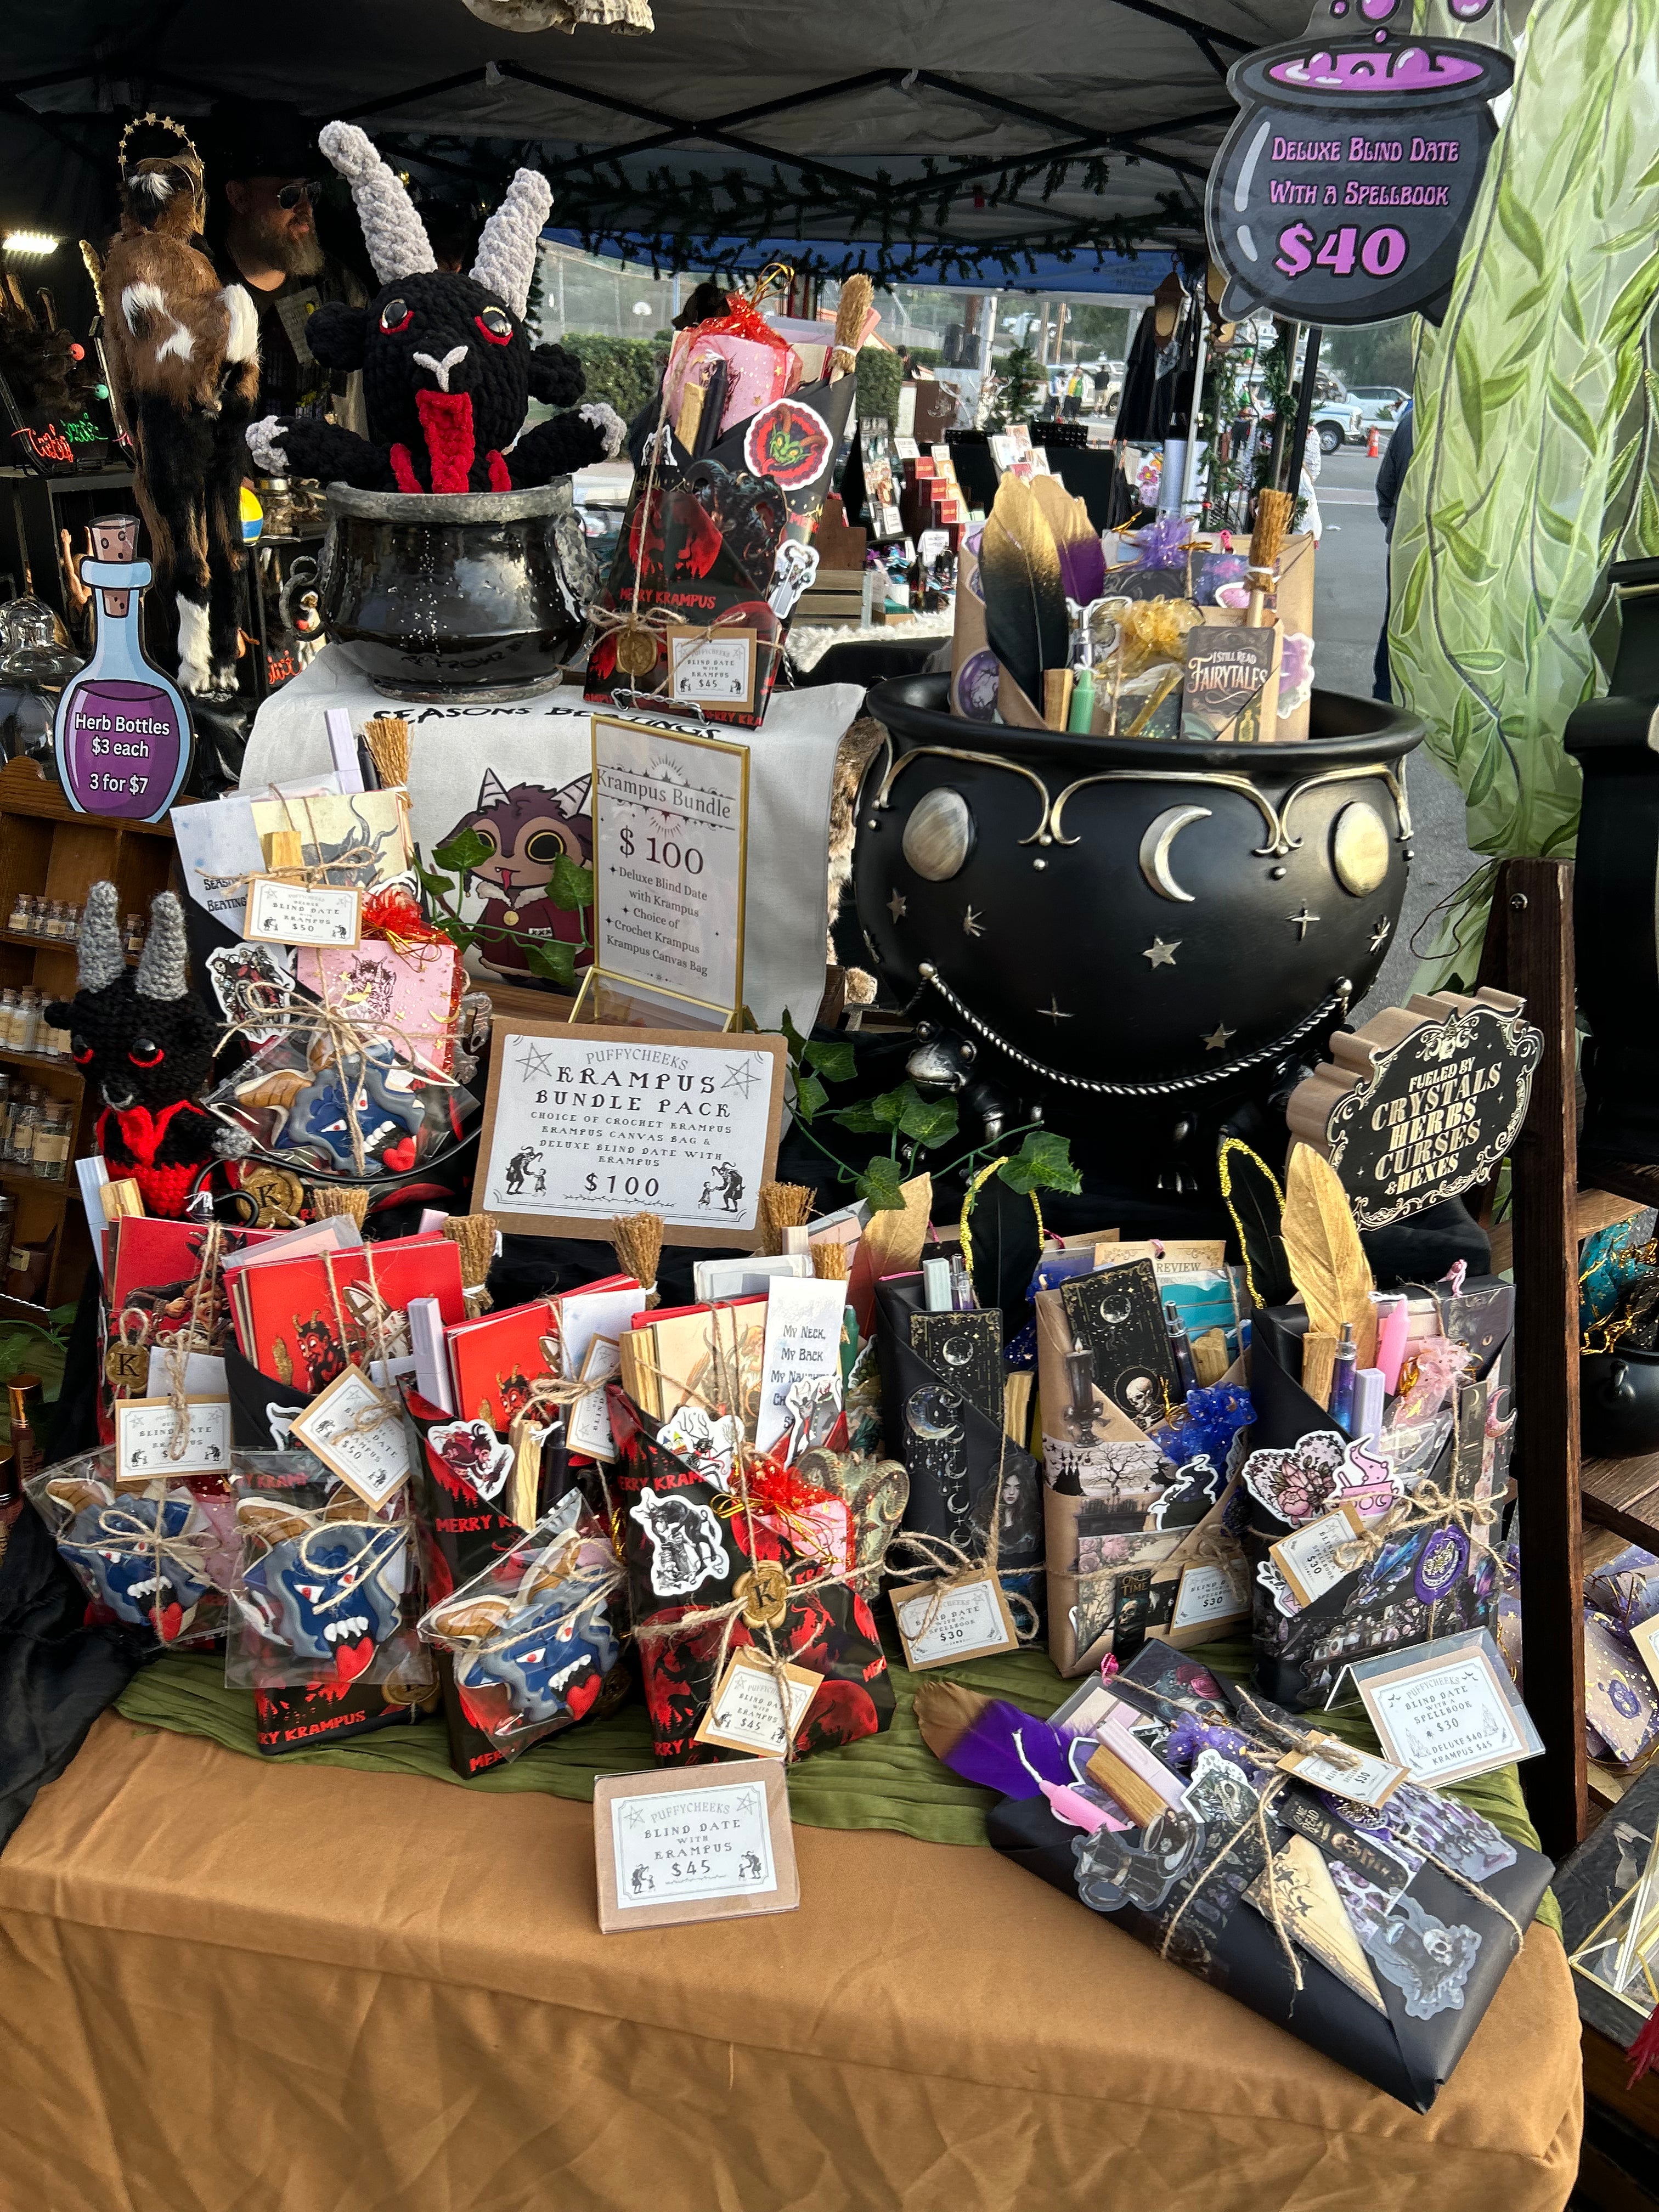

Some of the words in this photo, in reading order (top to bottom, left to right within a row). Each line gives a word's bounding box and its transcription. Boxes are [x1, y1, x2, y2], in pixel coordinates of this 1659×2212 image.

[1274, 222, 1407, 276] $40
[656, 591, 717, 610] KRAMPUS
[1237, 651, 1257, 664] READ
[698, 679, 718, 688] $45
[1187, 656, 1268, 693] FAIRYTALES
[75, 713, 111, 731] Herb
[115, 716, 170, 735] Bottles
[373, 707, 533, 725] SEASONS
[92, 736, 110, 755] $3
[113, 741, 149, 757] each
[89, 773, 99, 789] 3
[103, 774, 126, 792] for
[129, 774, 149, 795] $7
[597, 769, 666, 801] Krampus
[673, 788, 731, 819] Bundle
[619, 866, 653, 885] Deluxe
[655, 877, 681, 894] Blind
[684, 885, 708, 901] Date
[272, 902, 305, 912] BLIND
[629, 889, 651, 903] with
[653, 895, 699, 917] Krampus
[284, 915, 331, 924] KRAMPUS
[292, 923, 314, 932] $50
[633, 907, 667, 925] Choice
[668, 919, 680, 929] of
[614, 919, 652, 939] Crochet
[655, 932, 700, 953] Krampus
[606, 934, 650, 956] Krampus
[652, 949, 687, 968] Canvas
[690, 961, 708, 977] Bag
[586, 1048, 689, 1070] PUFFYCHEEKS
[556, 1066, 715, 1093] KRAMPUS
[1408, 1063, 1458, 1092] FUELED
[1458, 1056, 1476, 1074] BY
[535, 1090, 641, 1111] BUNDLE
[657, 1099, 731, 1118] PACK
[1371, 1062, 1502, 1131] CRYSTALS
[530, 1111, 577, 1121] CHOICE
[583, 1115, 600, 1124] OF
[605, 1117, 664, 1129] CROCHET
[1387, 1096, 1477, 1151] HERBS
[610, 1131, 664, 1142] CANVAS
[670, 1136, 697, 1145] BAG
[539, 1139, 590, 1150] DELUXE
[596, 1143, 635, 1154] BLIND
[641, 1147, 677, 1157] DATE
[684, 1150, 723, 1161] WITH
[1375, 1118, 1481, 1181] CURSES
[1384, 1181, 1397, 1195] &
[1396, 1152, 1459, 1195] HEXES
[254, 1183, 281, 1207] K
[584, 1172, 659, 1197] $100
[1156, 1262, 1201, 1273] REVIEW
[783, 1324, 798, 1339] My
[781, 1347, 796, 1361] My
[117, 1353, 141, 1377] K
[139, 1428, 174, 1437] BLIND
[653, 1470, 707, 1492] KRAM
[435, 1514, 493, 1533] MERRY
[1306, 1555, 1322, 1574] $30
[1121, 1582, 1147, 1596] TIME
[1190, 1582, 1217, 1592] BLIND
[951, 1605, 980, 1618] DATE
[1203, 1596, 1223, 1607] $30
[928, 1619, 976, 1634] SPELLBOOK
[940, 1629, 964, 1642] $30
[1405, 1695, 1436, 1711] BLIND
[1440, 1685, 1468, 1699] DATE
[1406, 1676, 1460, 1700] PUFFYCHEEKS
[738, 1693, 764, 1705] BLIND
[1425, 1701, 1447, 1711] WITH
[737, 1707, 778, 1723] KRAMPUS
[1413, 1700, 1472, 1724] SPELLBOOK
[284, 1709, 367, 1742] KRAMPUS
[740, 1718, 762, 1730] $45
[1436, 1717, 1459, 1732] $30
[1431, 1737, 1465, 1754] DELUXE
[1466, 1731, 1483, 1743] $40
[1432, 1746, 1474, 1765] KRAMPUS
[1476, 1740, 1492, 1751] $45
[651, 1802, 730, 1824] PUFFYCHEEKS
[644, 1825, 691, 1839] BLIND
[699, 1819, 741, 1832] DATE
[676, 1835, 709, 1844] WITH
[654, 1842, 732, 1860] KRAMPUS
[671, 1859, 711, 1877] $45
